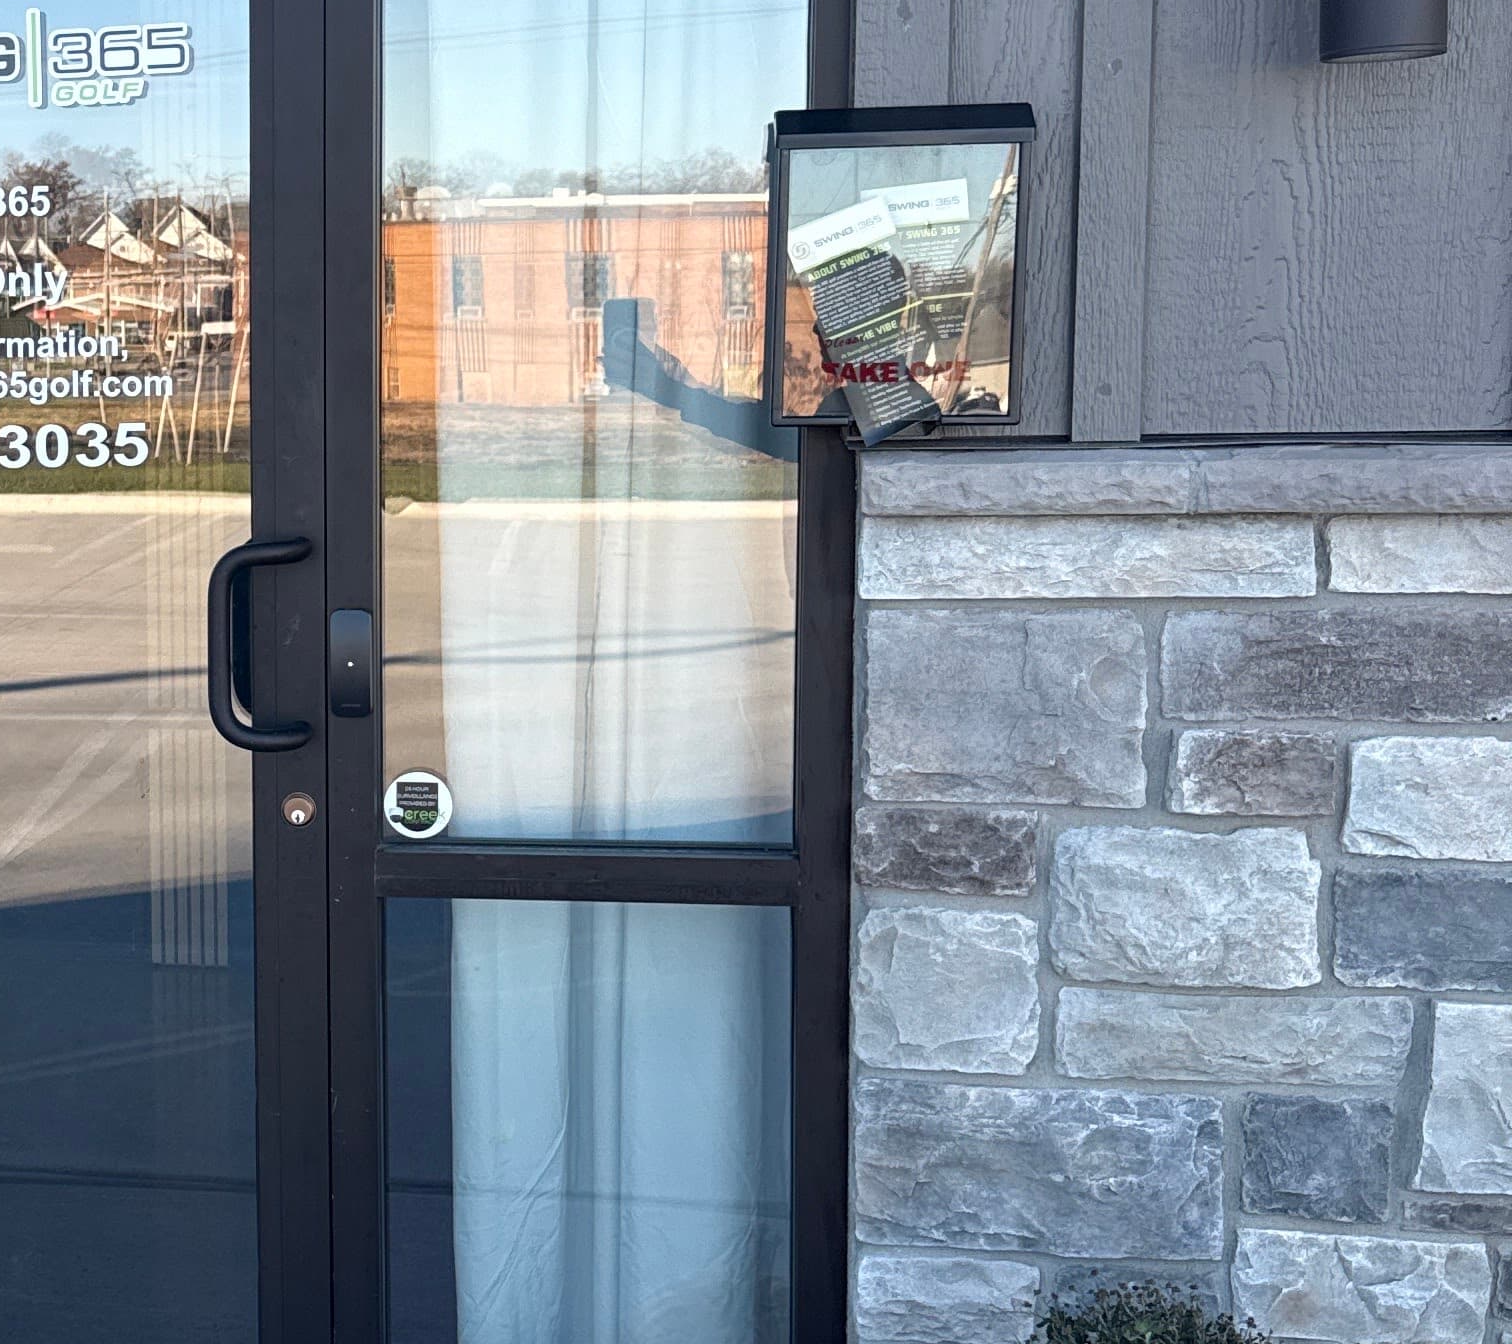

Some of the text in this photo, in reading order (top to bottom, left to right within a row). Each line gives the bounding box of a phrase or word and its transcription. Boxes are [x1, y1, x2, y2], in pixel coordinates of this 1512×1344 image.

[51, 25, 187, 75] 365
[54, 80, 144, 104] GOLF
[888, 199, 930, 212] SWING
[813, 226, 855, 248] SWING
[807, 263, 839, 283] ABOUT
[839, 250, 871, 270] SWING
[876, 319, 899, 335] VIBE
[822, 360, 972, 383] TAKE ONE
[404, 808, 446, 821] creek
